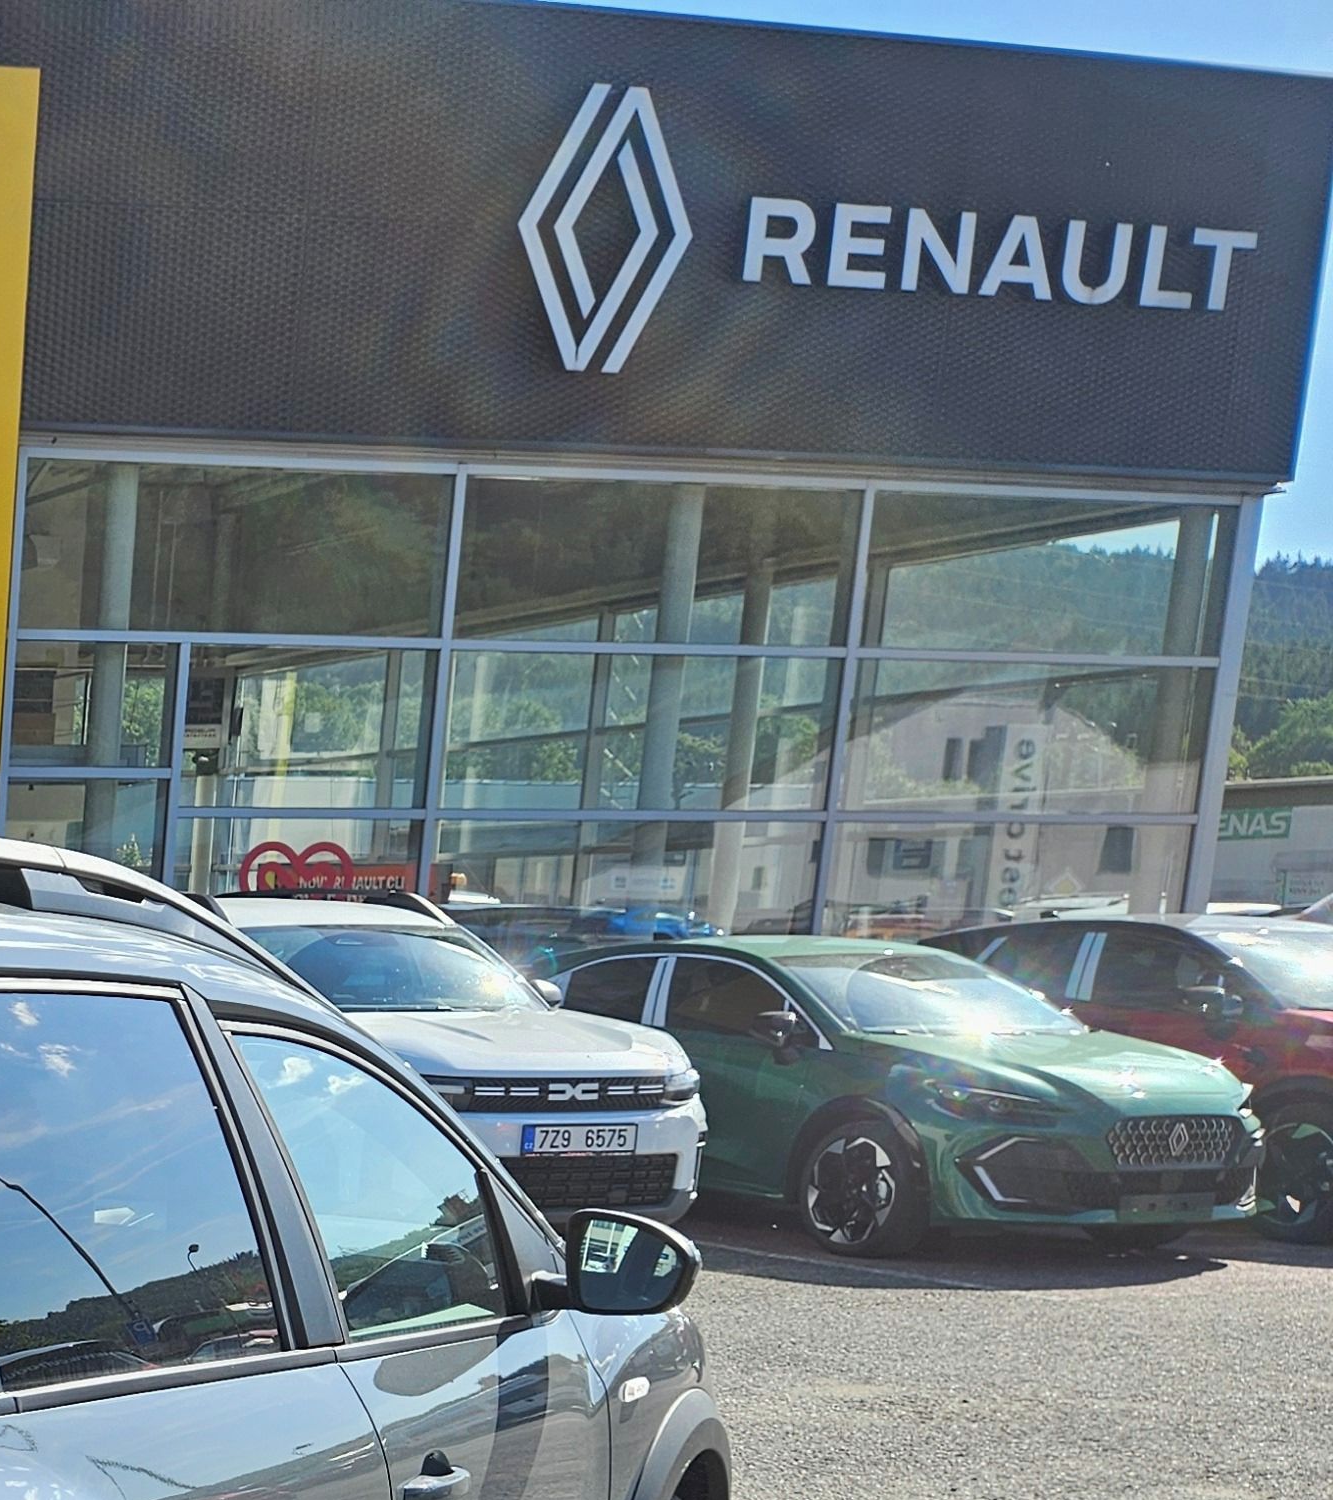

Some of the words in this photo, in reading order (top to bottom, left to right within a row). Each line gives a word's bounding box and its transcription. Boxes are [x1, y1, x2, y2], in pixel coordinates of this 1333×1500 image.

[742, 196, 1259, 312] RENAULT
[299, 874, 328, 890] NOV
[538, 1129, 572, 1149] 7Z9
[585, 1128, 628, 1148] 6575
